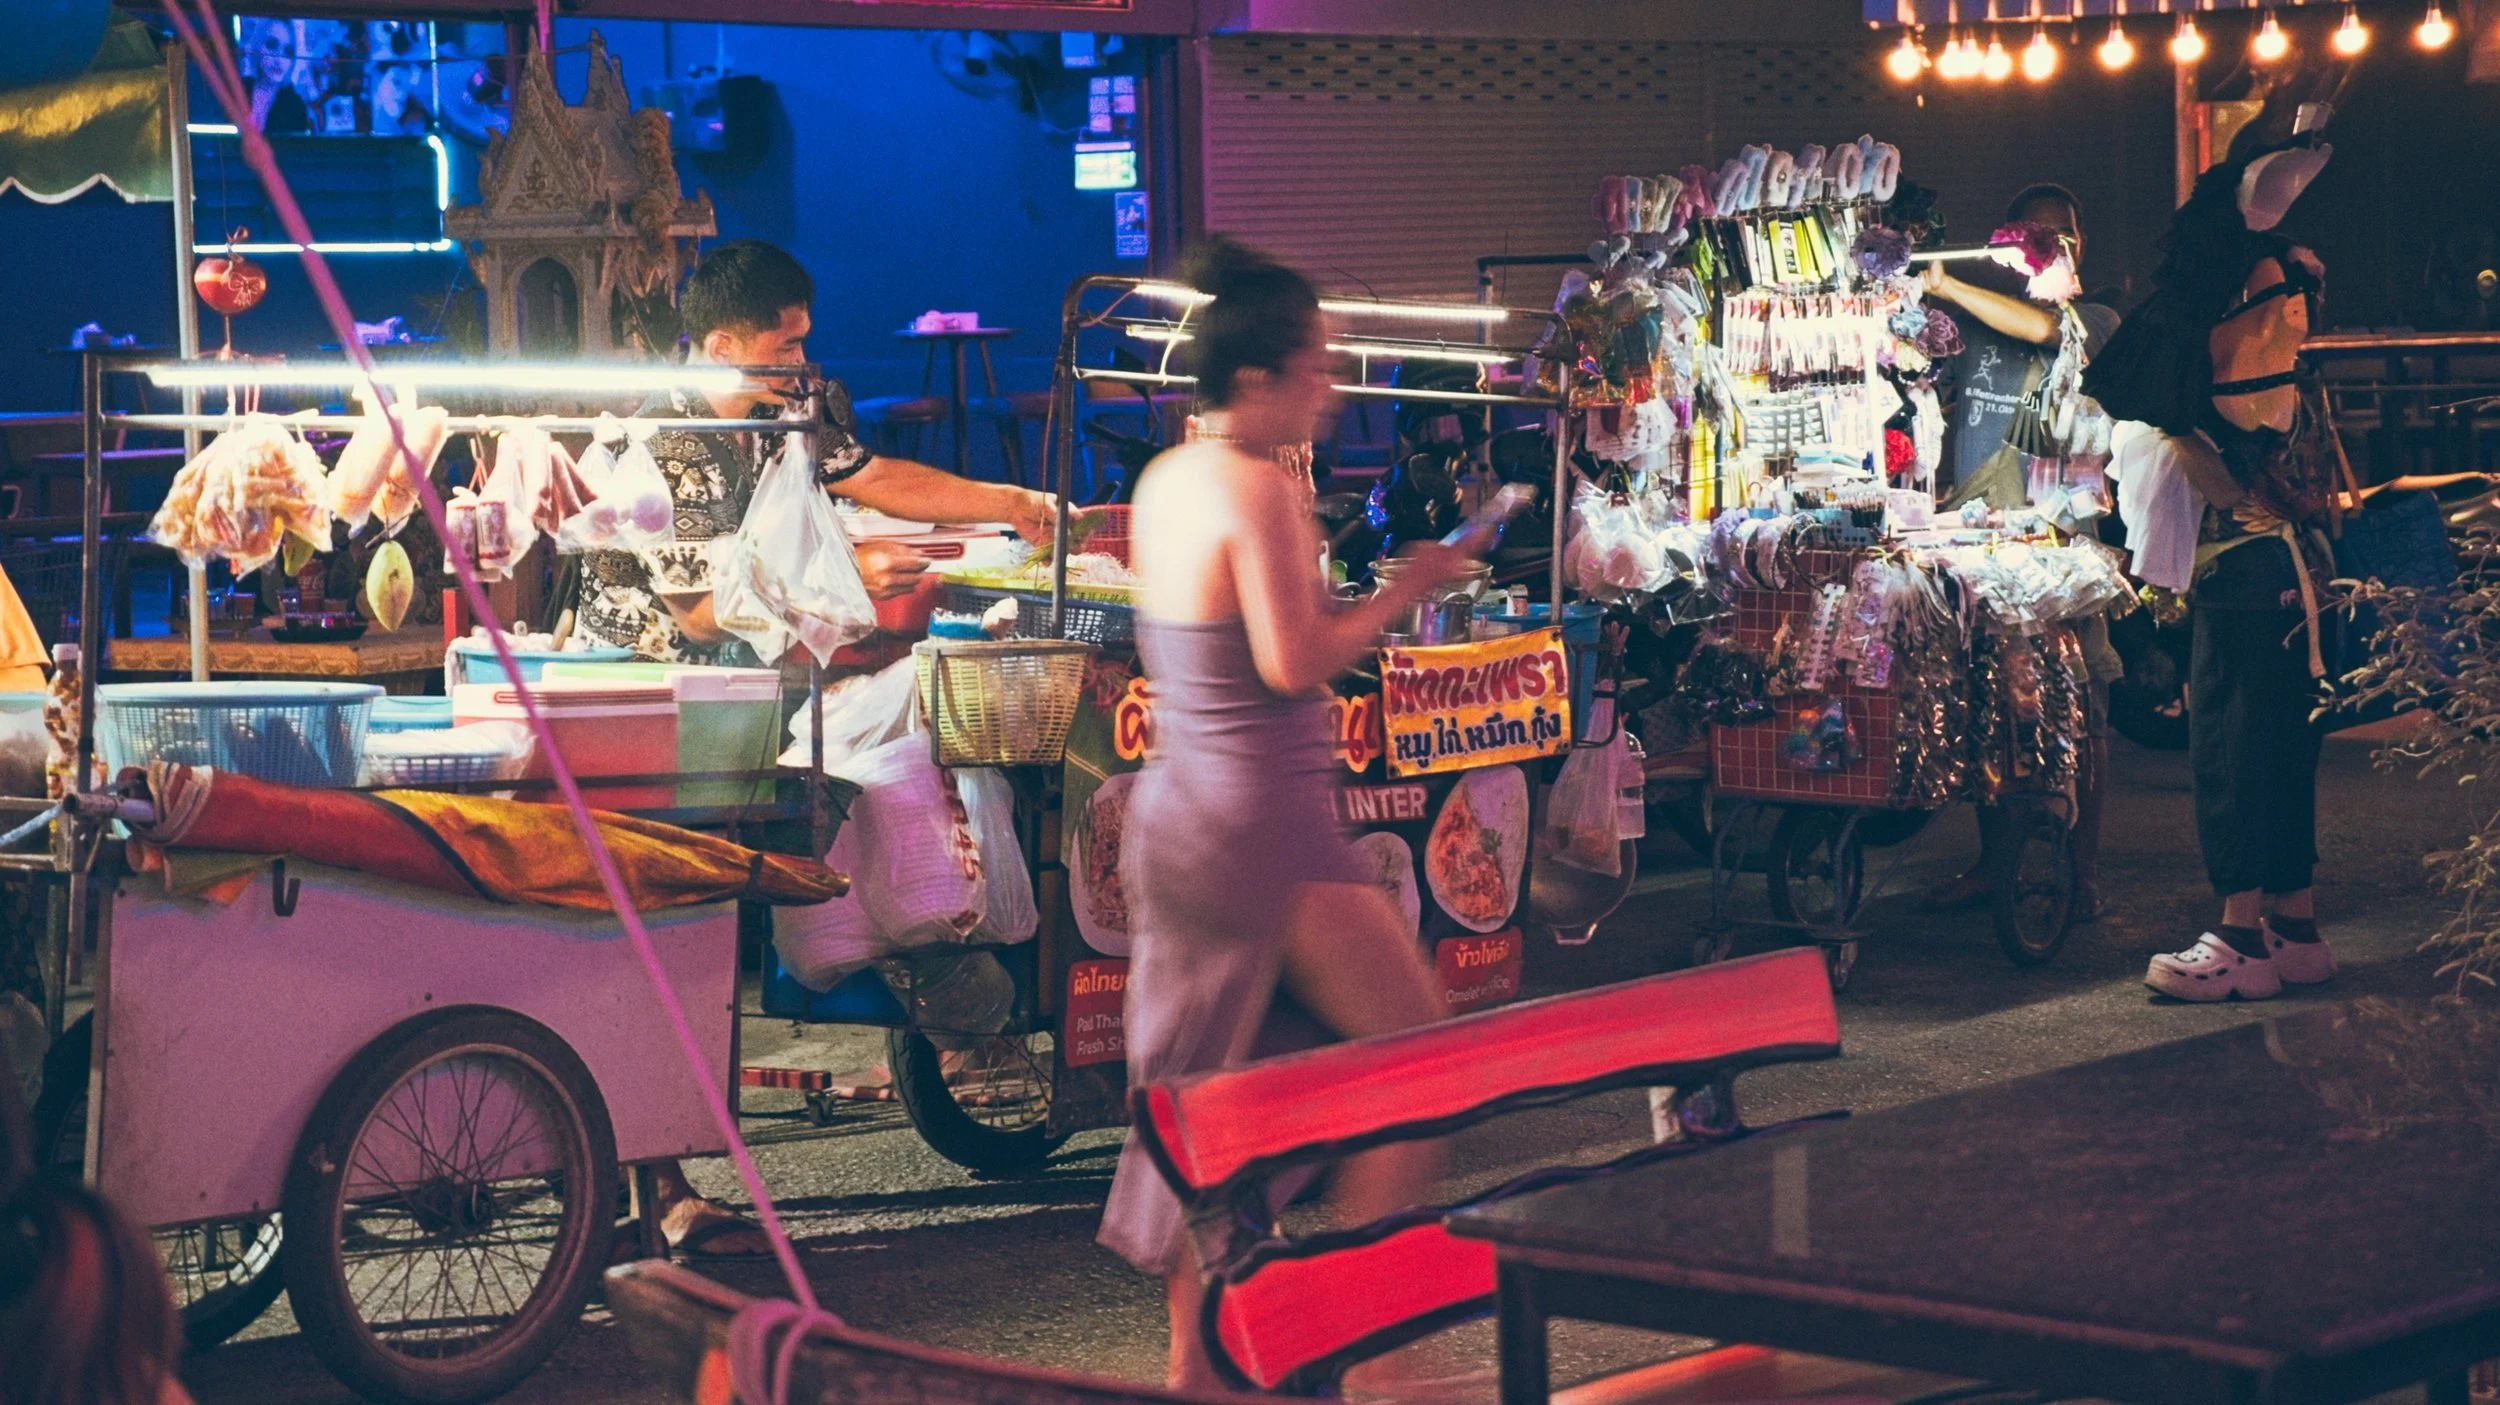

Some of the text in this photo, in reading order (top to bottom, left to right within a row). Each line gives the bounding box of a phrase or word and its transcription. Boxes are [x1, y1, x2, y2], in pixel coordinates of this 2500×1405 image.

[1345, 786, 1427, 820] INTER
[1076, 1016, 1094, 1033] Pad
[1076, 1038, 1104, 1056] Fresh
